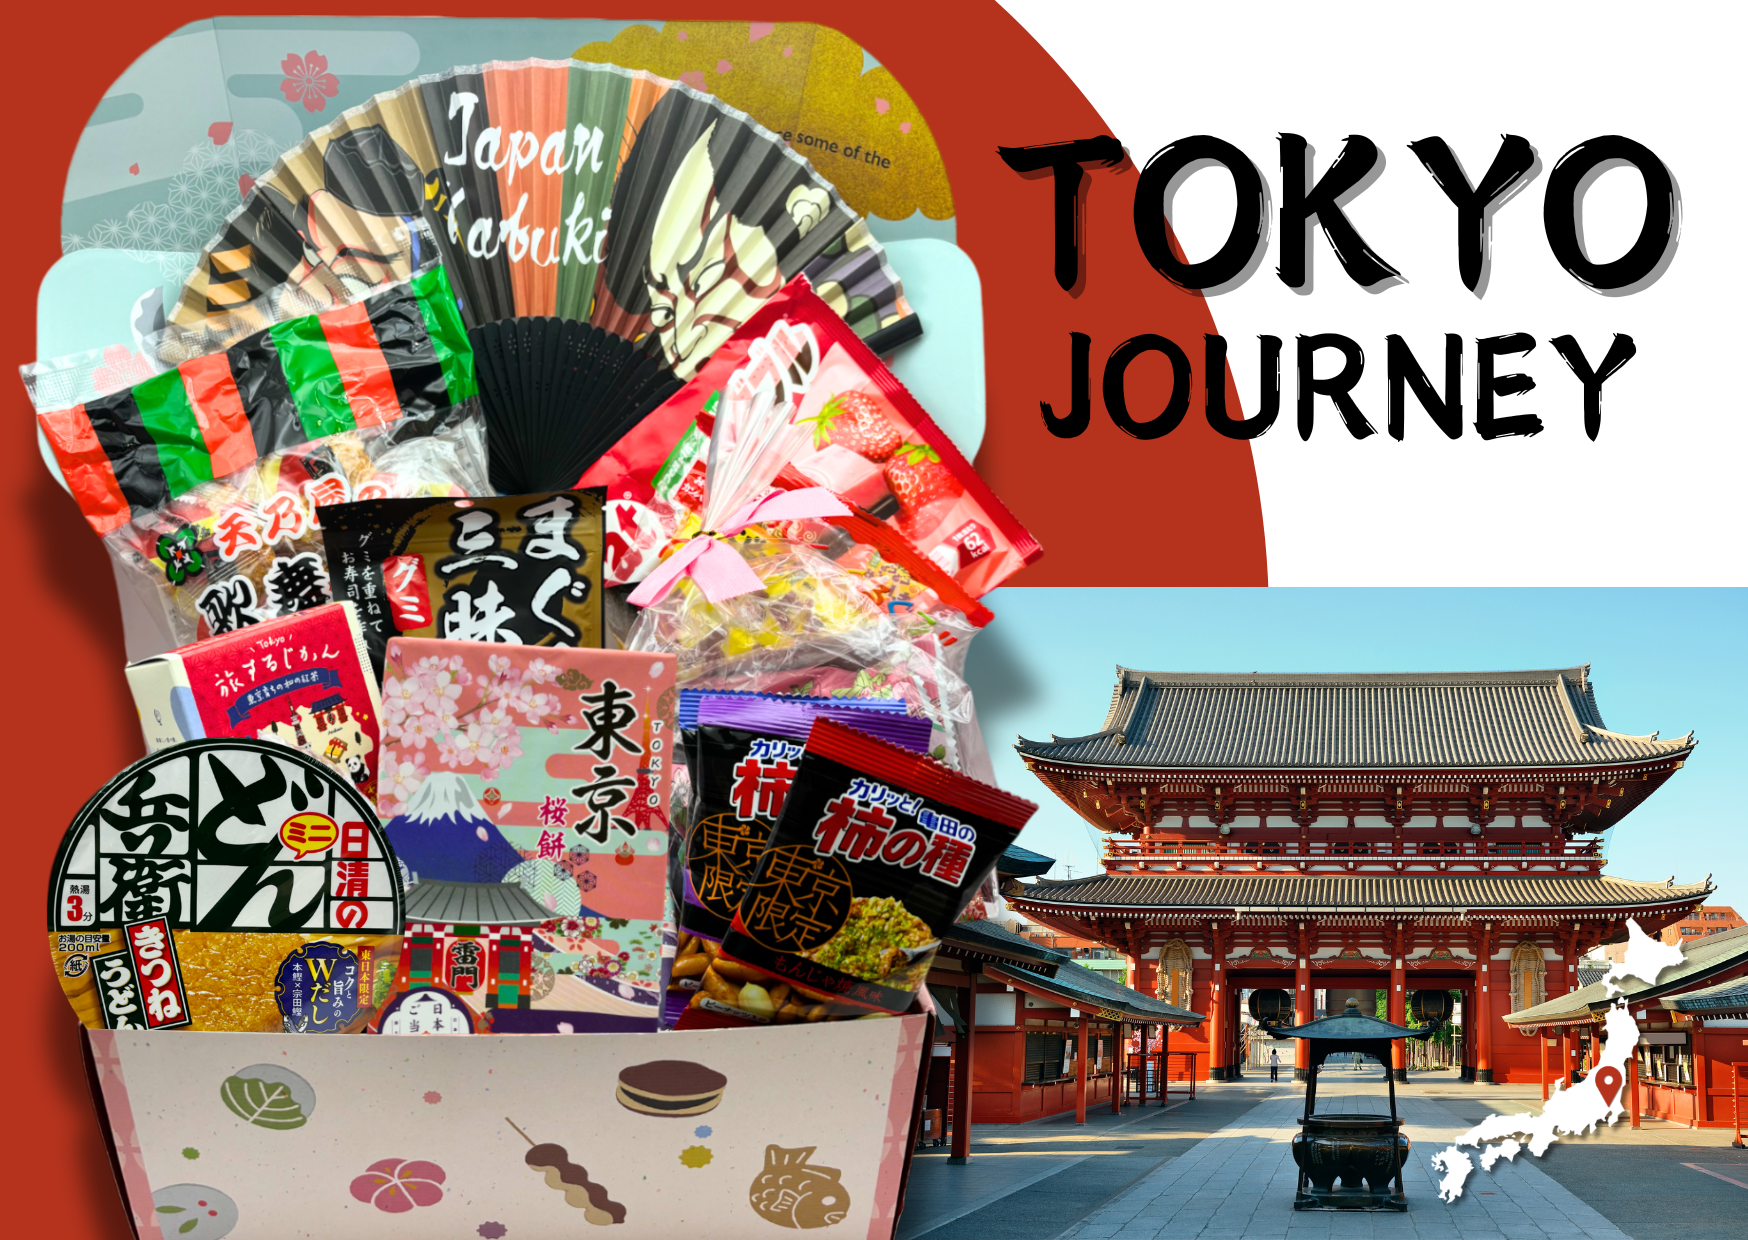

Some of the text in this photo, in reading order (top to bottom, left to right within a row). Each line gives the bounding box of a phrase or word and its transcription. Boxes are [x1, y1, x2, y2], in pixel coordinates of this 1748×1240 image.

[444, 91, 604, 186] Japan
[797, 132, 838, 153] some
[843, 146, 861, 159] of
[865, 150, 891, 169] the
[963, 531, 985, 551] 62
[970, 543, 991, 559] kcal
[359, 531, 383, 632] グミを重ねて
[392, 557, 426, 623] グミ
[523, 496, 586, 647] まぐ
[255, 634, 286, 650] Tokyo
[214, 643, 340, 698] 旅するじかん
[246, 670, 320, 706] 東京育ちの和の紅茶
[572, 680, 642, 843] 東京
[648, 721, 663, 807] TOKYO
[732, 758, 799, 818] 柿
[286, 823, 332, 844] ミニ
[536, 795, 569, 860] 桜餅
[848, 778, 975, 843] カリッと! 亀田の
[100, 770, 192, 922] 兵衛
[195, 753, 325, 930] どん
[815, 796, 973, 885] 柿の種
[69, 884, 90, 895] 熱湯
[336, 821, 370, 928] 日清の
[765, 846, 840, 917] 東京
[66, 895, 93, 922] 3分
[747, 895, 832, 951] 限定
[58, 934, 111, 943] お湯の目安量
[58, 943, 100, 952] 200ml
[69, 959, 83, 972] 紙
[451, 939, 481, 991] 雷門
[134, 925, 182, 1022] きつね
[304, 958, 338, 1024] Wだし
[332, 980, 344, 1018] 旨みの
[344, 965, 356, 999] コクと
[358, 949, 372, 1006] 東日本限定
[432, 1003, 445, 1032] 日本
